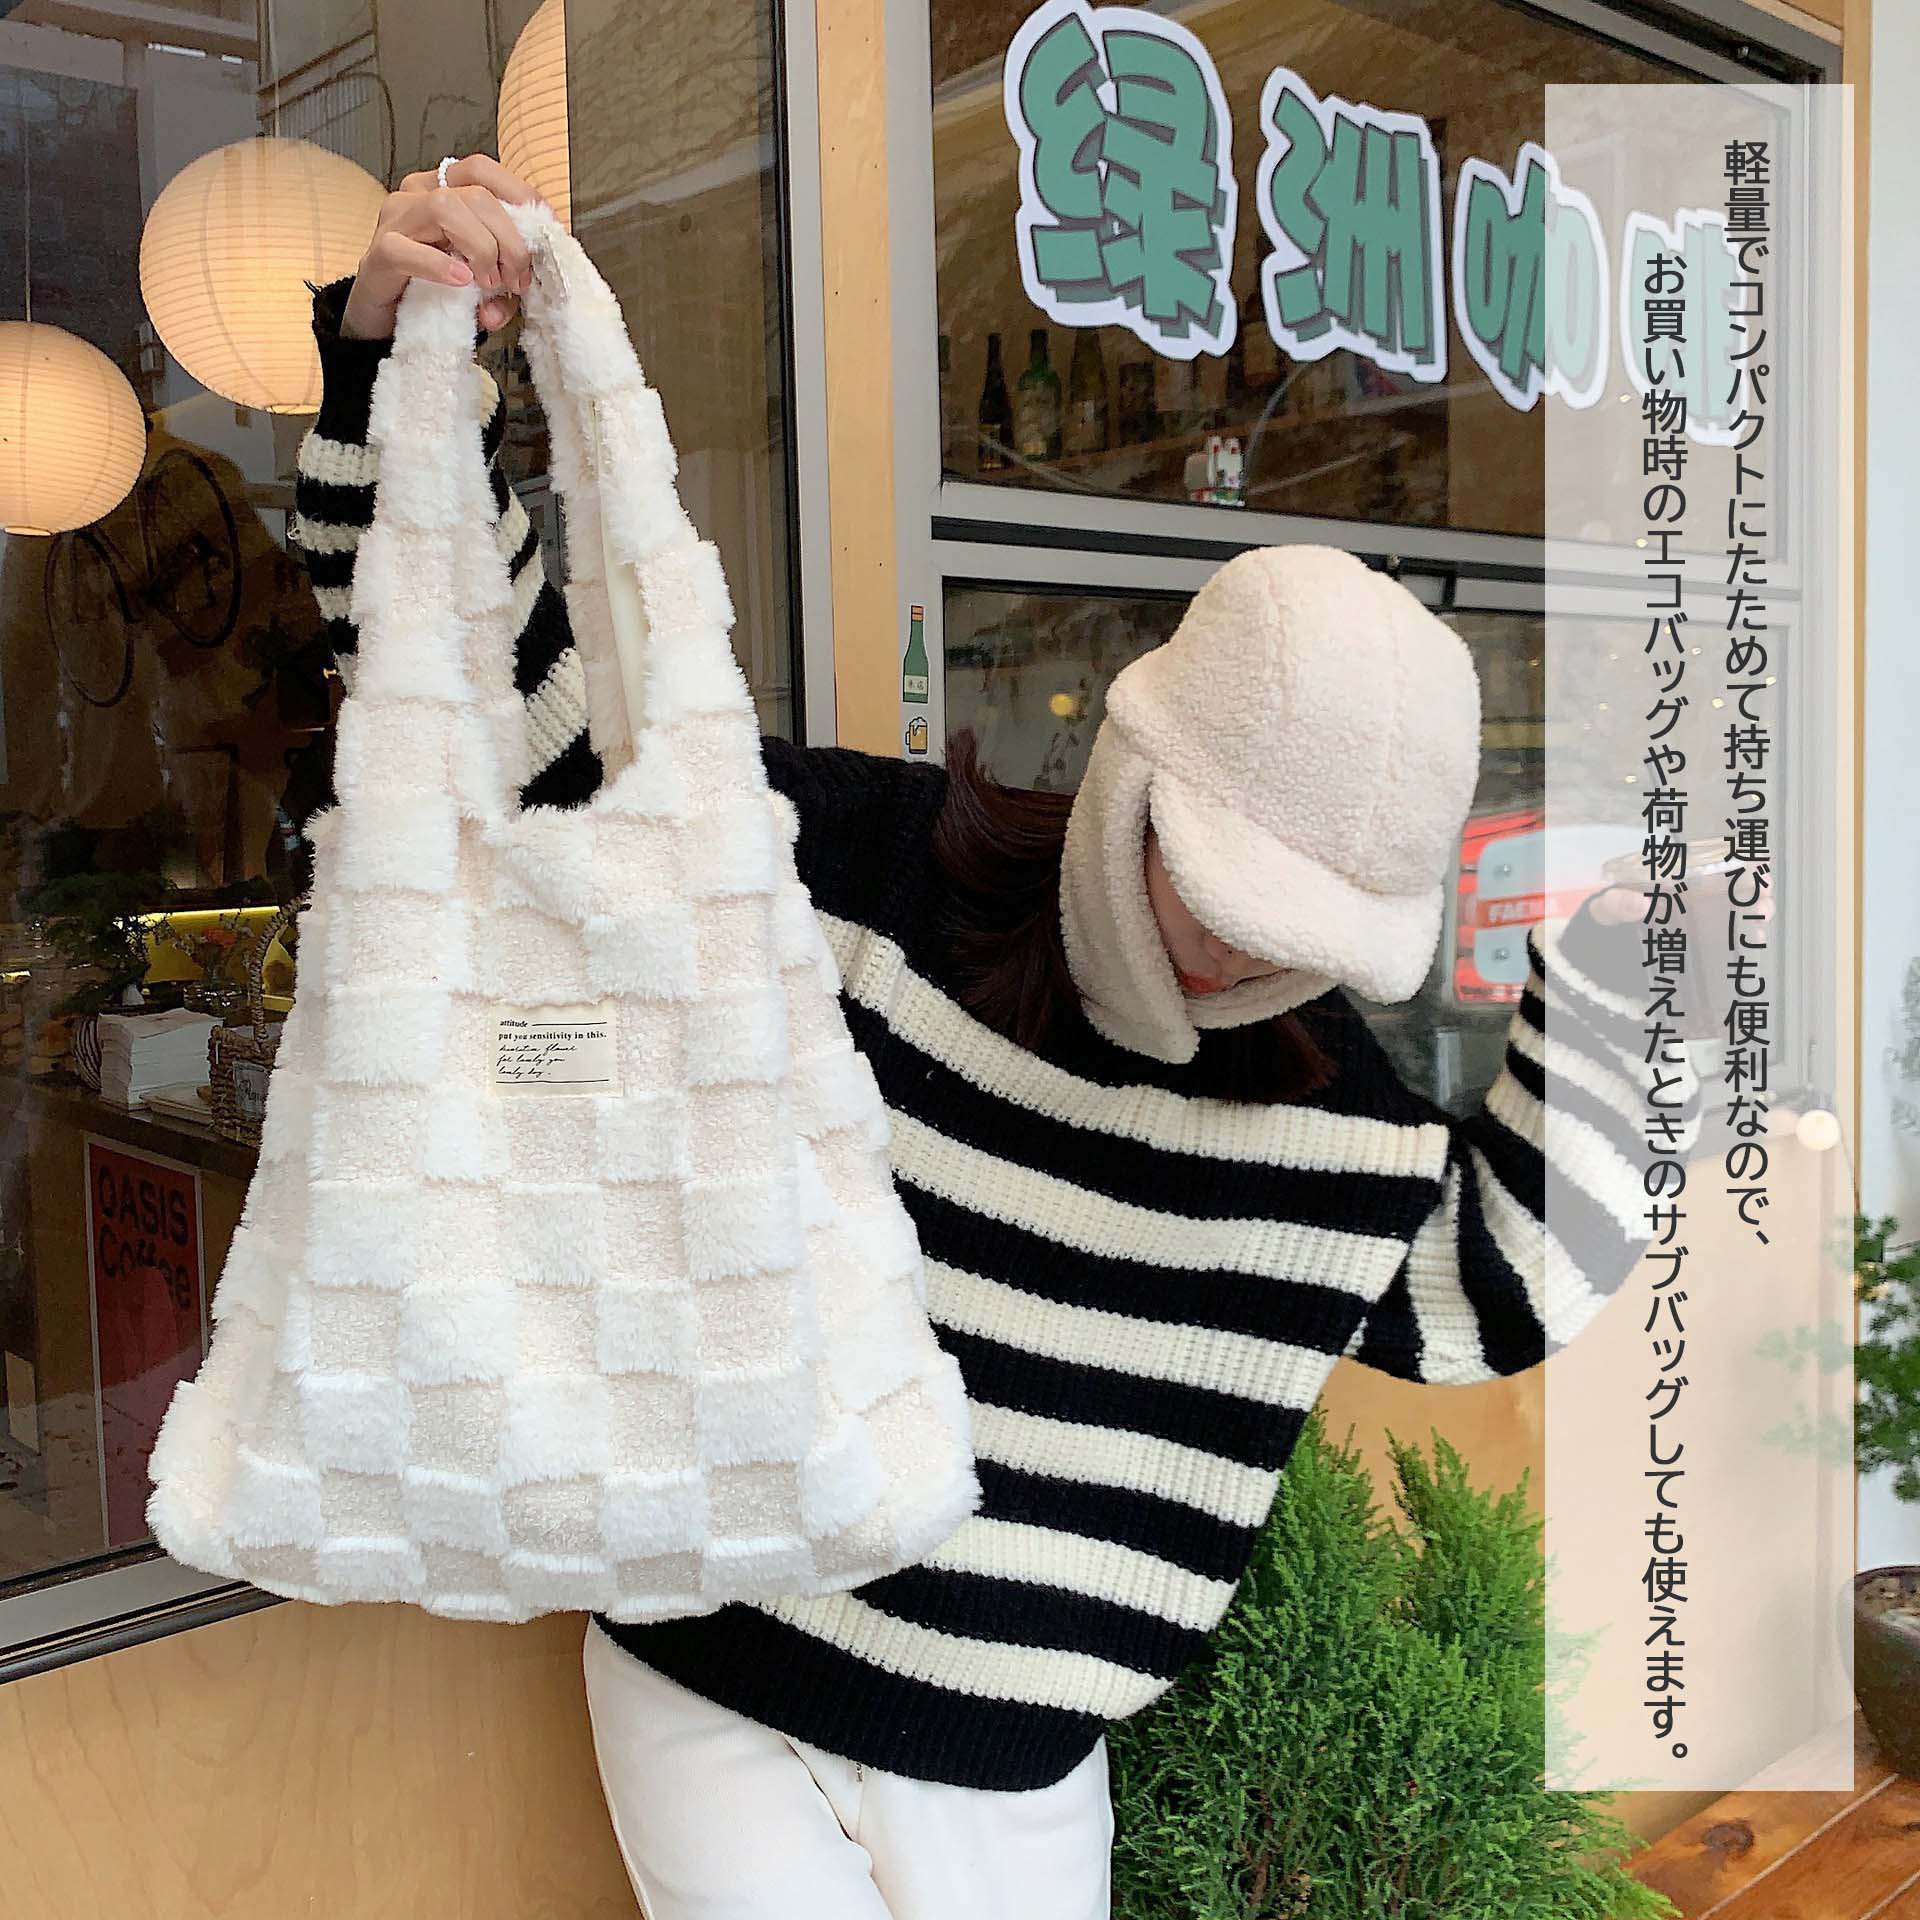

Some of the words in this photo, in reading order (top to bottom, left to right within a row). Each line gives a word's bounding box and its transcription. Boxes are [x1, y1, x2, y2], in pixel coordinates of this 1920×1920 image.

[499, 1019, 529, 1028] attitude
[498, 1033, 512, 1041] put
[529, 1031, 571, 1041] sensitivity
[574, 1031, 584, 1040] in
[586, 1031, 607, 1039] this.
[98, 1166, 190, 1247] OASIS
